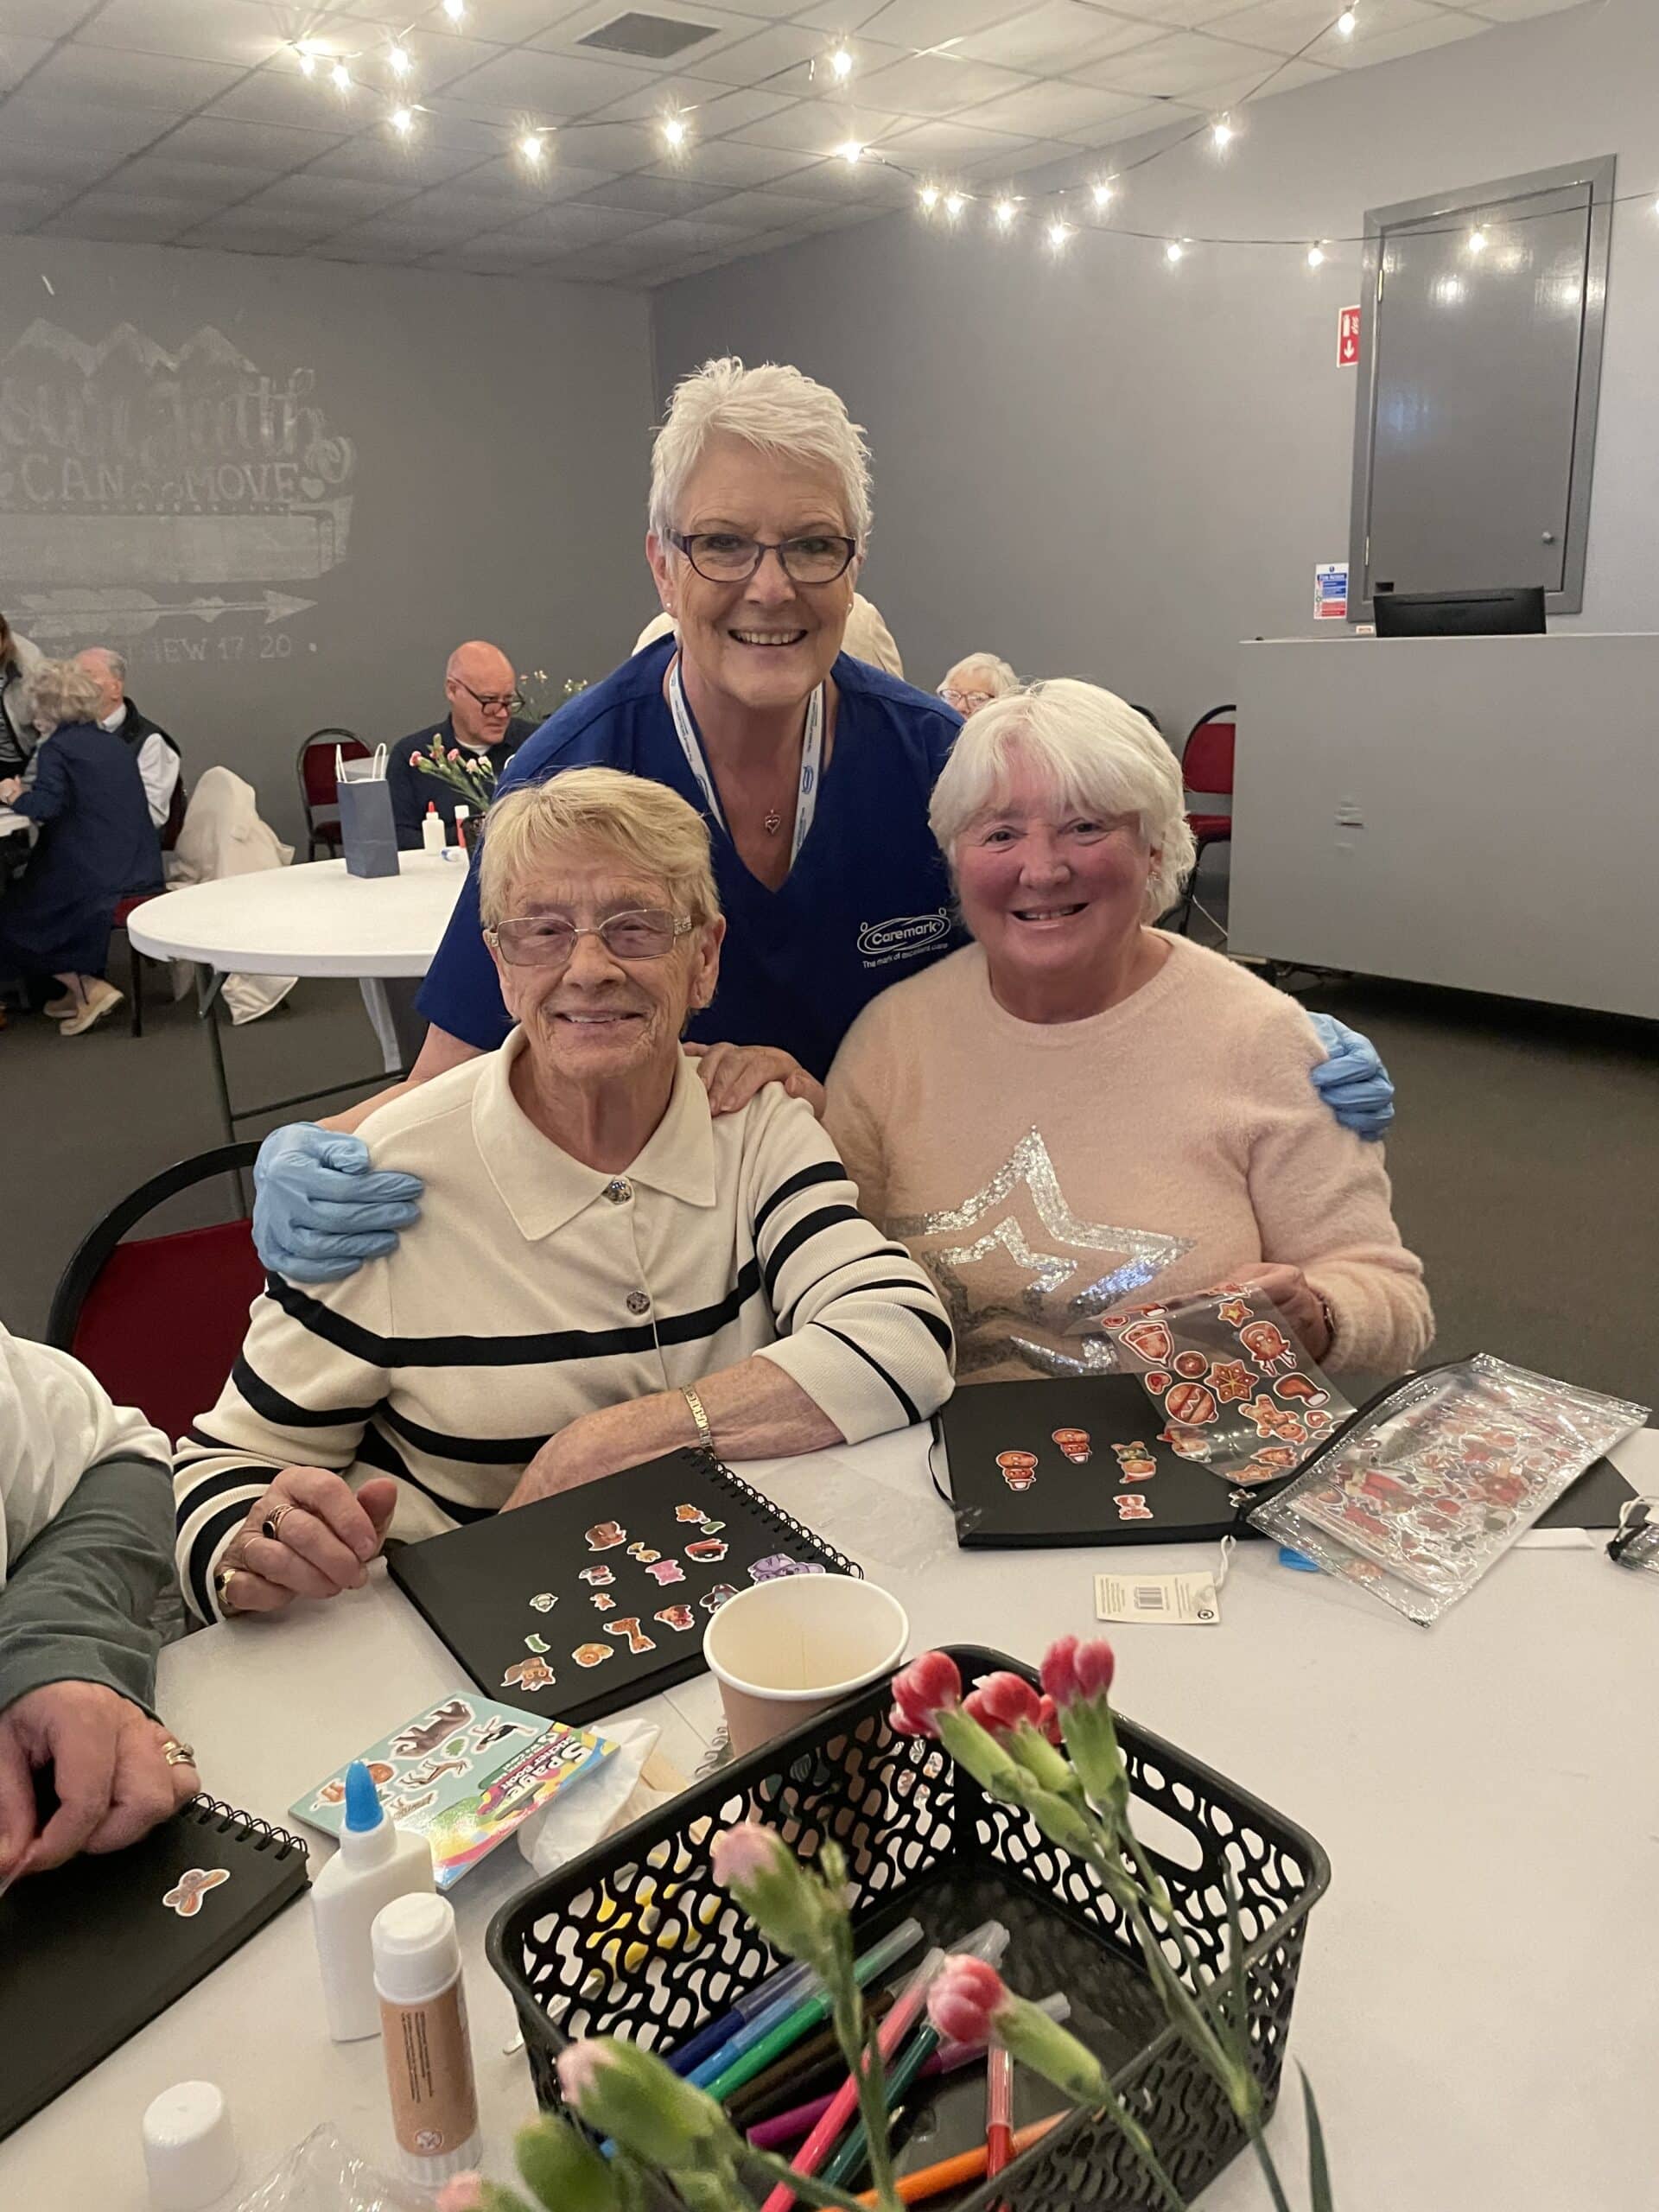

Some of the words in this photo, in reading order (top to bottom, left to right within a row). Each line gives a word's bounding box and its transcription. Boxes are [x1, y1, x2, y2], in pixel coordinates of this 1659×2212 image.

[21, 454, 124, 502] CAN
[184, 462, 299, 503] MOVE
[871, 921, 938, 945] Caremark
[862, 960, 876, 969] The
[877, 956, 893, 965] mark
